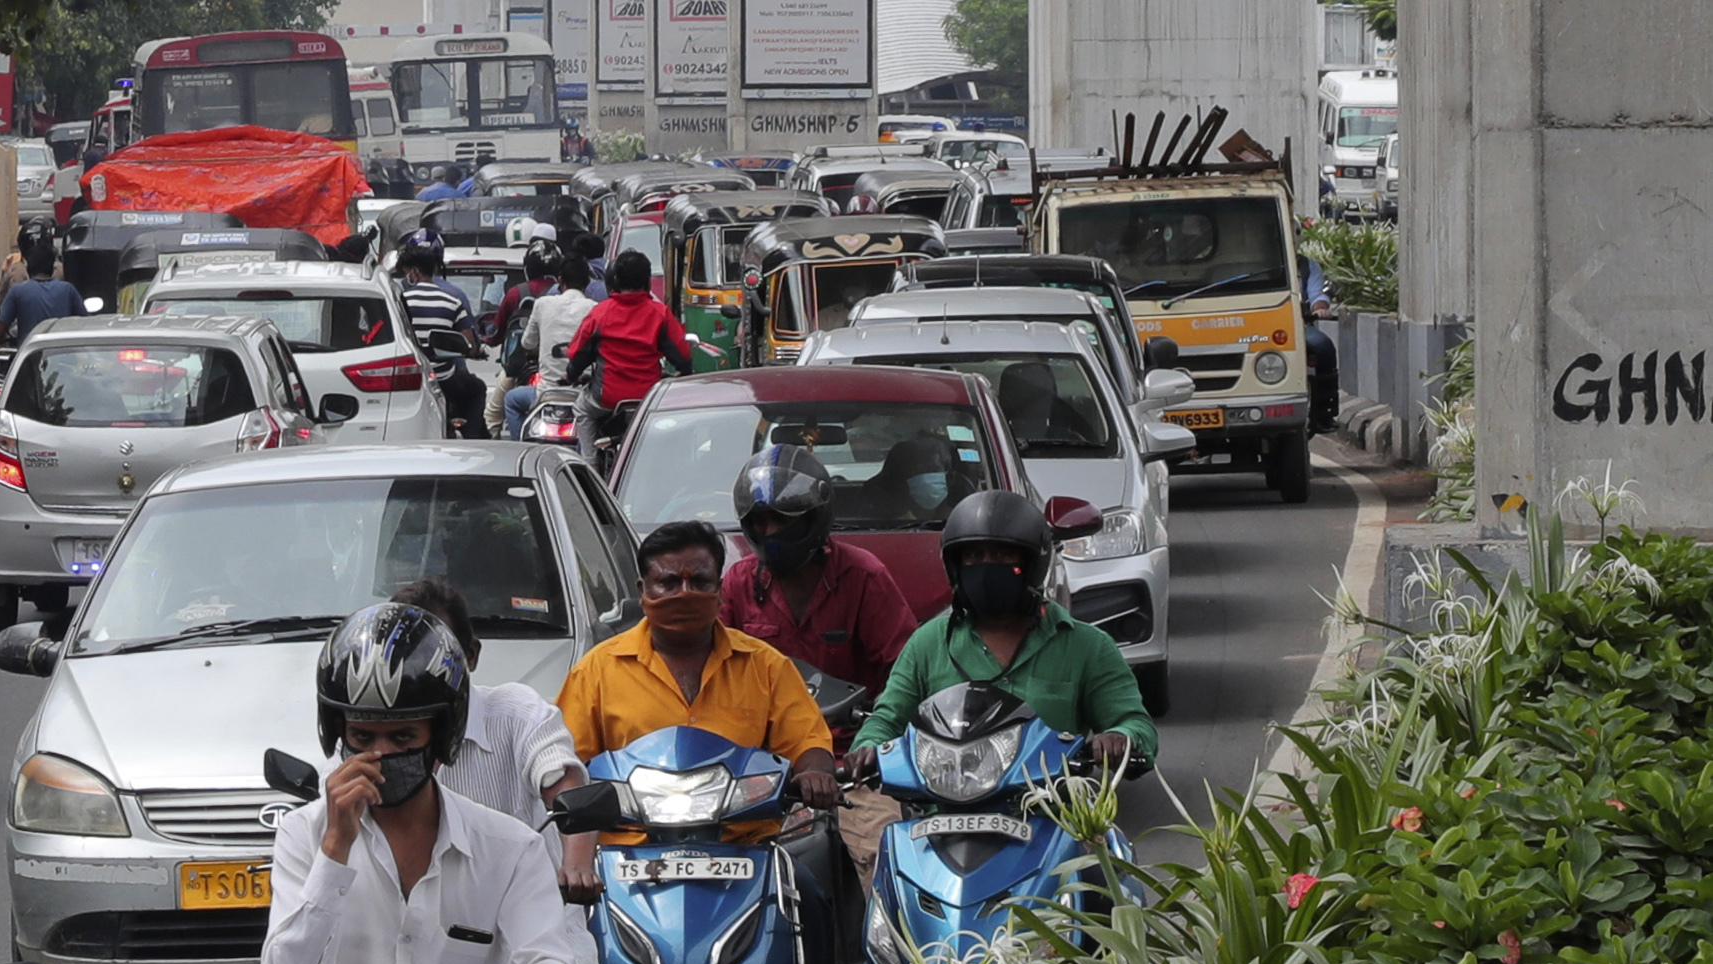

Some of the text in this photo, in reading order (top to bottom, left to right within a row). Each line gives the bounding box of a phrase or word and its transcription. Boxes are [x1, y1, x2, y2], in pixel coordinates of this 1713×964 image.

[1137, 317, 1245, 331] ODS CARRIER
[922, 817, 1029, 838] TS 13EF 9578
[660, 850, 711, 859] HONDA
[620, 861, 748, 878] TS FC 2471
